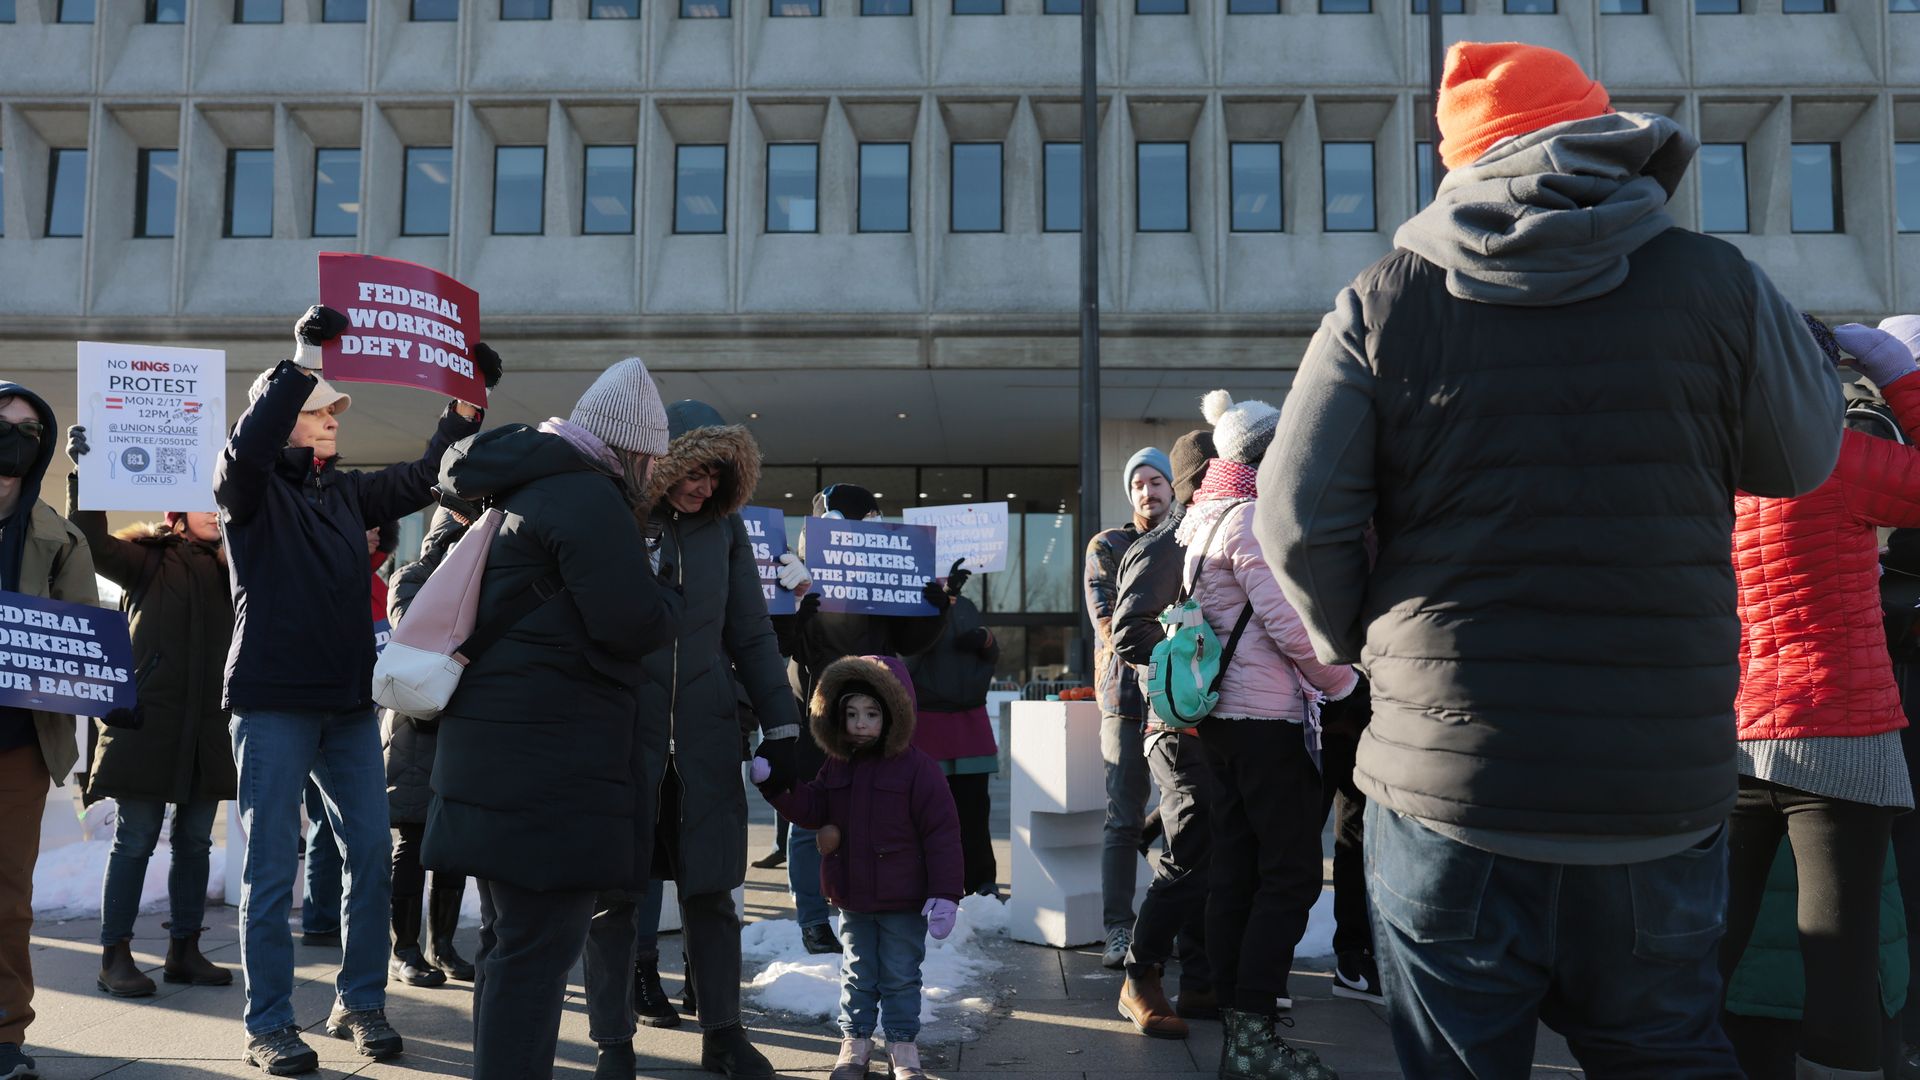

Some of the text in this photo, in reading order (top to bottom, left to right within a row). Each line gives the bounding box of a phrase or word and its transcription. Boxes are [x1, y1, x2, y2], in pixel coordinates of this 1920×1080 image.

[358, 281, 462, 325] FEDERAL
[347, 307, 469, 356] WORKERS,
[107, 359, 199, 374] NO KINGS DAY
[341, 335, 475, 380] DEFY DOGE!
[109, 375, 197, 394] PROTEST
[124, 396, 182, 407] MON 2/17
[138, 409, 169, 419] 12PM
[108, 423, 198, 435] @ UNION SQUARE
[108, 435, 198, 447] LINKTR.EE/50501DC
[136, 474, 172, 484] JOIN US
[830, 530, 912, 551] FEDERAL
[823, 549, 919, 574] WORKERS,
[811, 567, 844, 582] THE
[846, 570, 899, 586] PUBLIC
[822, 585, 922, 604] YOUR BACK!
[0, 604, 95, 636] DERAL
[83, 663, 128, 683] HAS
[38, 676, 114, 703] BACK!
